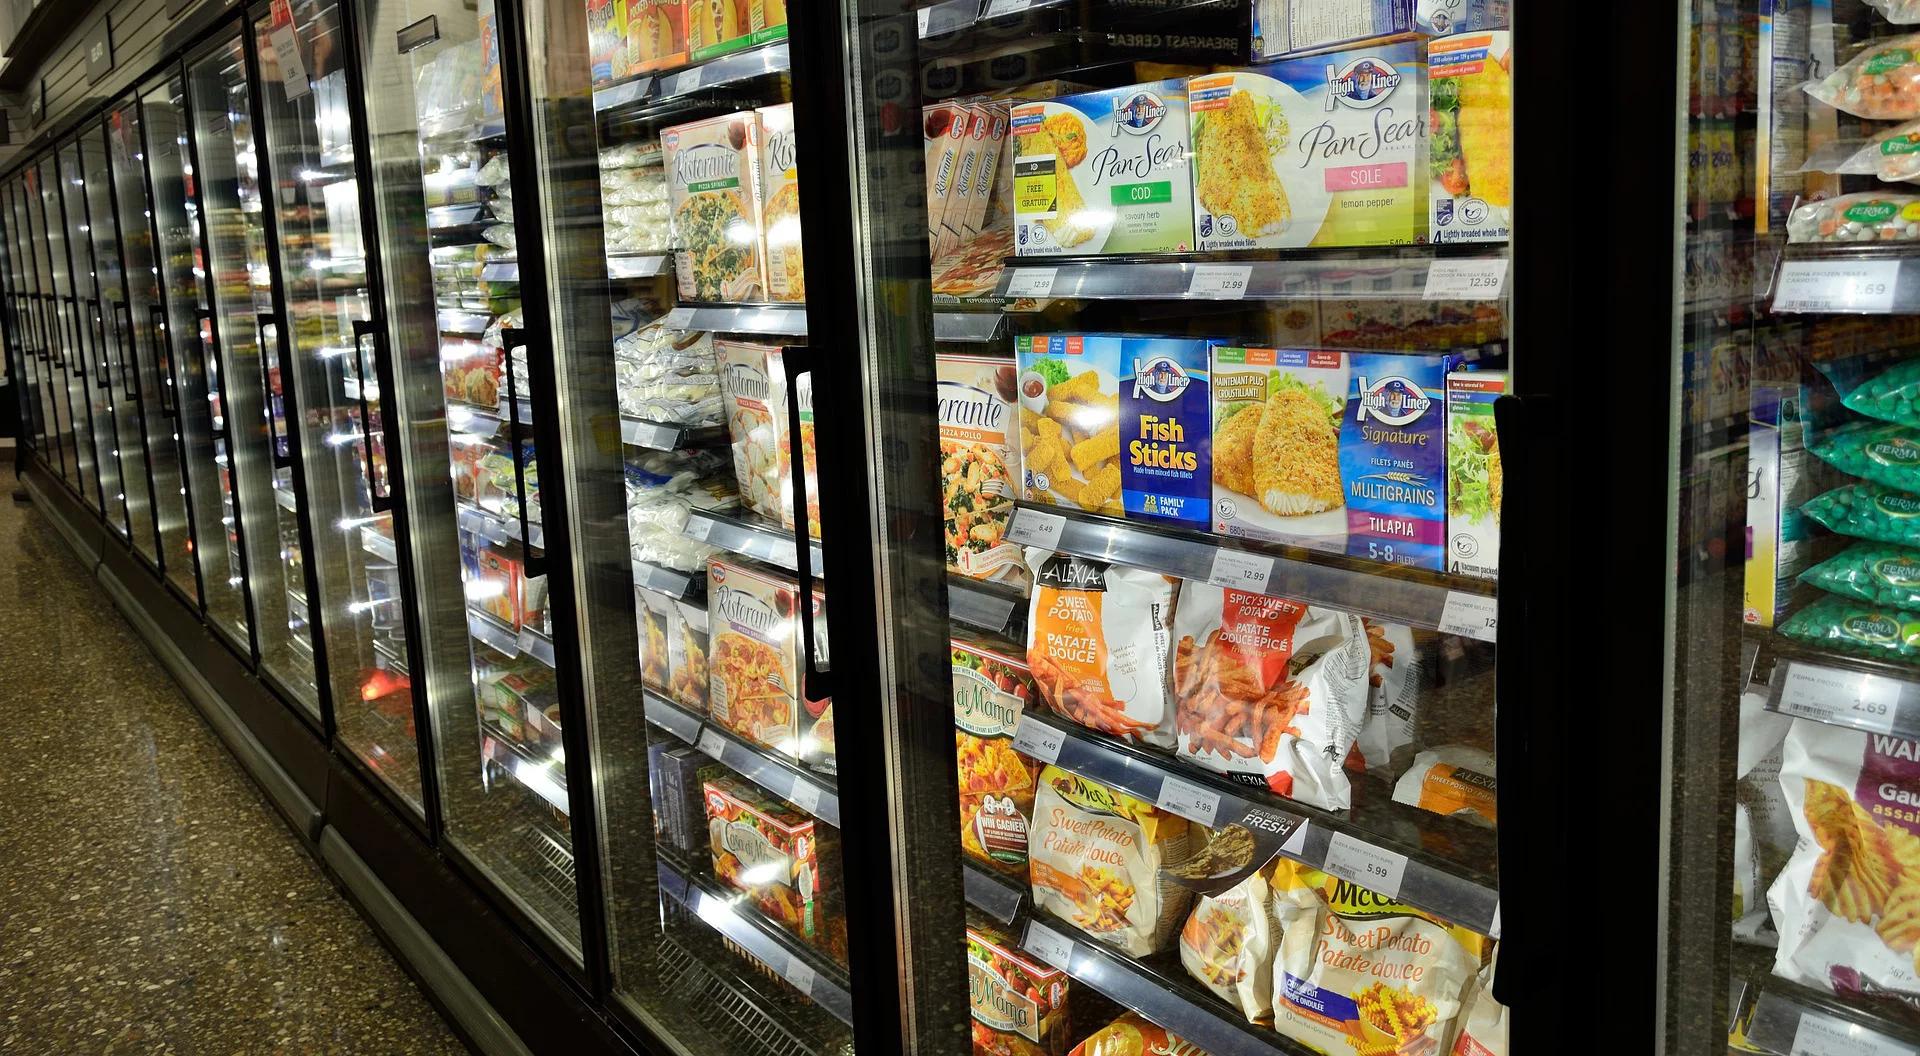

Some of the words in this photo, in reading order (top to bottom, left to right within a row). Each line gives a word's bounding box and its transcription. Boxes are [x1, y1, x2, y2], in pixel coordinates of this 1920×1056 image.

[1331, 78, 1354, 96] High
[1372, 72, 1398, 89] Liner
[1115, 109, 1133, 126] High
[1145, 104, 1167, 119] Liner
[1298, 107, 1427, 169] Pan-Sear
[673, 148, 736, 186] Ristorante
[1091, 134, 1187, 187] Pan-Sear
[935, 148, 954, 197] Ristorante
[956, 149, 977, 198] Ristorante
[975, 150, 997, 198] Ristorante
[1350, 169, 1382, 184] SOLE
[697, 182, 711, 190] PIZZA
[1026, 184, 1044, 193] FREE!
[1131, 187, 1151, 200] COD
[1340, 199, 1364, 209] lemon
[1366, 197, 1394, 210] pepper
[1849, 206, 1891, 217] FERMA
[1125, 212, 1146, 221] savoury
[1146, 211, 1160, 219] herb
[1433, 230, 1443, 243] 4
[1443, 229, 1460, 240] Lightly
[1460, 228, 1481, 237] breaded
[1481, 228, 1497, 237] whole
[1033, 280, 1050, 288] 12.99
[1221, 280, 1243, 289] 12.99
[1469, 277, 1498, 287] 12.99
[725, 362, 769, 400] Ristorante
[1138, 371, 1155, 388] High
[1168, 374, 1189, 388] Liner
[1214, 375, 1248, 387] MAINTENANT
[1249, 375, 1264, 387] PLUS
[1218, 387, 1260, 399] CROUSTILLANT!
[1363, 392, 1386, 408] High
[1402, 394, 1429, 411] Liner
[940, 427, 958, 438] PIZZA
[960, 431, 982, 440] POLLO
[1139, 414, 1184, 443] Fish
[1362, 425, 1427, 446] Signature
[1129, 440, 1198, 471] Sticks
[1874, 443, 1918, 460] FERMA
[1370, 457, 1391, 468] FILETS
[1393, 458, 1414, 469] PANÉS
[1170, 470, 1179, 478] fish
[1179, 471, 1193, 479] fillets
[1144, 494, 1157, 505] 28
[1160, 496, 1185, 508] FAMILY
[1351, 481, 1435, 507] MULTIGRAINS
[1161, 506, 1179, 517] PACK
[1038, 524, 1054, 533] 6.49
[1229, 525, 1246, 537] 680g
[1369, 517, 1414, 537] TILAPIA
[1369, 542, 1394, 560] 5-8
[1396, 554, 1415, 566] FILETS
[1042, 563, 1098, 585] ALEXIA
[1243, 570, 1265, 581] 12.99
[1450, 560, 1461, 575] 4
[1461, 562, 1479, 573] Vacuum
[1480, 564, 1498, 576] packed
[1056, 595, 1089, 610] SWEET
[1229, 592, 1258, 607] SPICY
[1257, 596, 1300, 615] SWEET
[1047, 606, 1094, 623] POTATO
[1239, 605, 1279, 621] POTATO
[1065, 623, 1085, 633] fries
[1236, 622, 1271, 637] PATATE
[1851, 620, 1892, 634] FERMA
[1047, 633, 1097, 651] PATATE
[1219, 631, 1254, 648] DOUCE
[1048, 646, 1096, 664] DOUCE
[956, 686, 970, 708] di
[966, 683, 1015, 727] Mama
[1852, 699, 1888, 716] 2.69
[1042, 739, 1057, 751] 4.49
[1232, 773, 1266, 787] ALEXIA
[1431, 774, 1450, 787] SWEET
[1449, 781, 1473, 793] POTATO
[1194, 799, 1212, 813] 5.99
[1250, 808, 1286, 824] FEATURED
[982, 816, 995, 828] WIN
[996, 817, 1025, 833] GAGNER
[1242, 813, 1292, 836] FRESH
[1366, 863, 1388, 878] 5.99
[1320, 912, 1374, 950] Sweet
[1375, 926, 1432, 956] Potato
[1371, 955, 1424, 982] douce
[976, 976, 1027, 1027] Mama
[1307, 989, 1318, 998] CUT
[1299, 997, 1325, 1012] ONDULÉE
